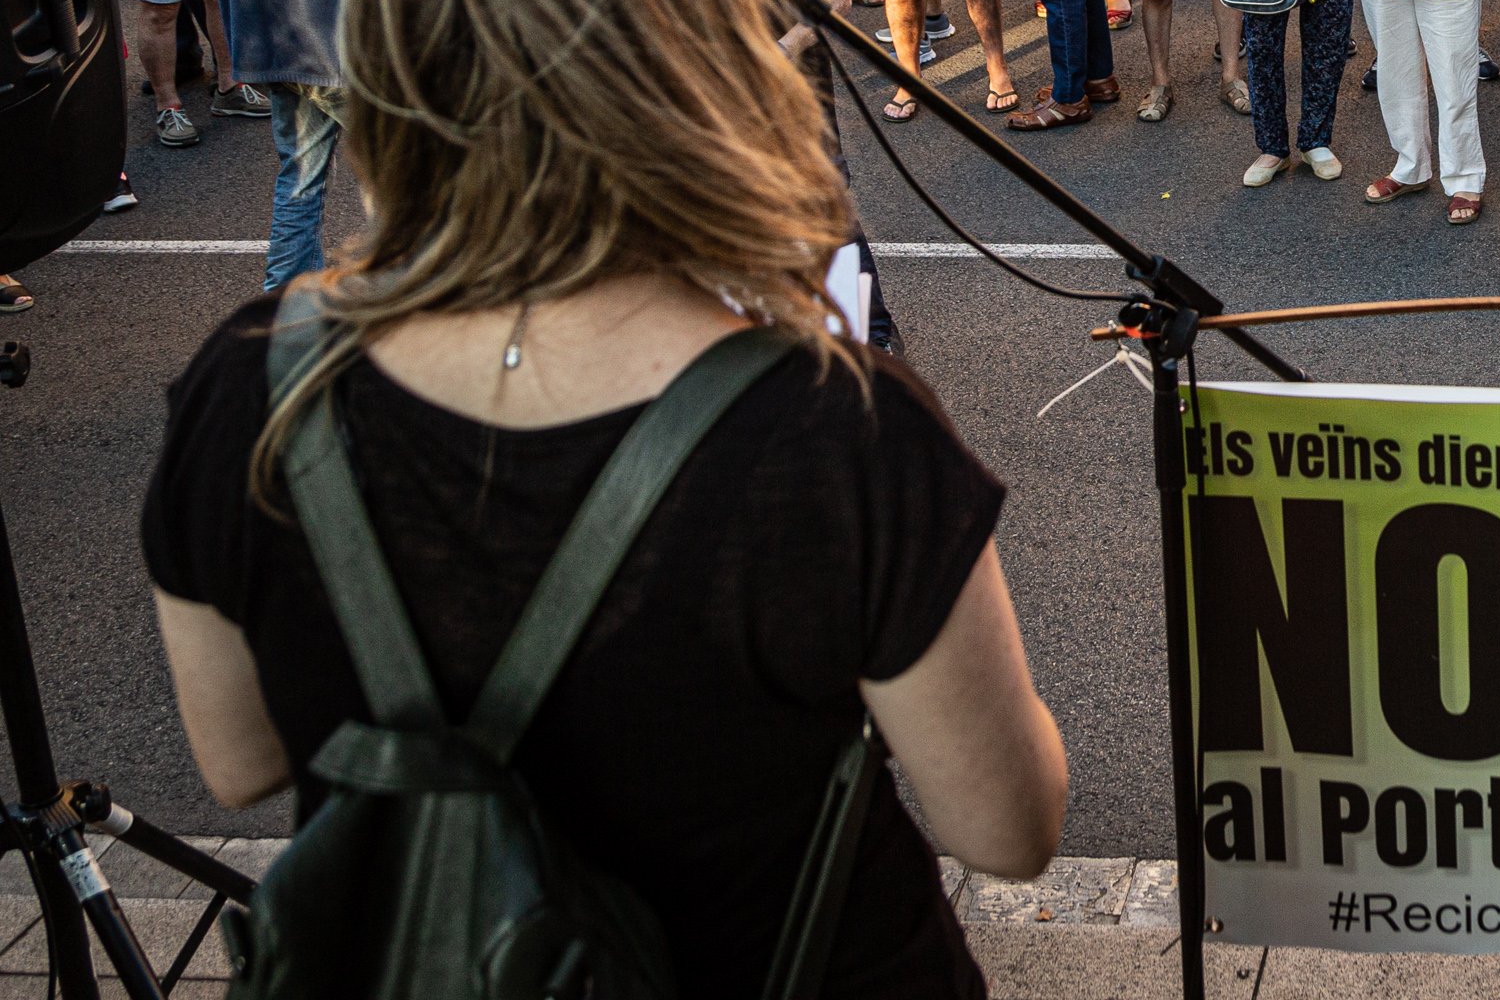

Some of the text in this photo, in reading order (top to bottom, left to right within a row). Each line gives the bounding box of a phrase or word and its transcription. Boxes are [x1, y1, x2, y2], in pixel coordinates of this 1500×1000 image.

[1185, 422, 1254, 477] Els
[1268, 423, 1402, 483] veïns
[1203, 767, 1287, 862] al
